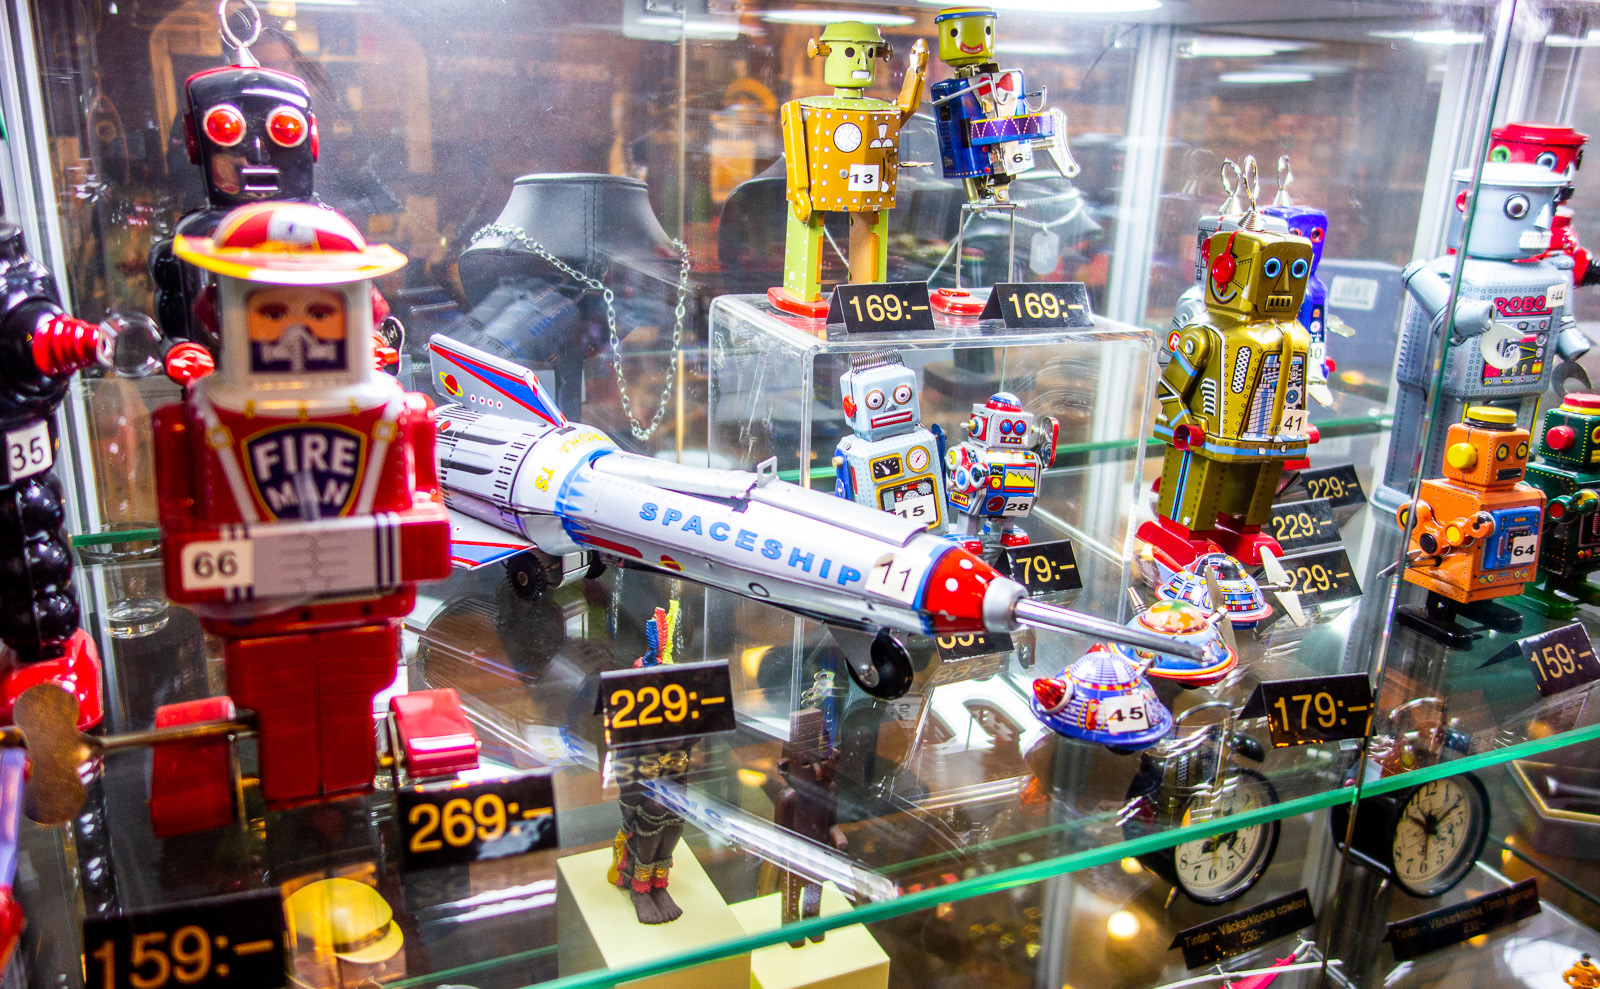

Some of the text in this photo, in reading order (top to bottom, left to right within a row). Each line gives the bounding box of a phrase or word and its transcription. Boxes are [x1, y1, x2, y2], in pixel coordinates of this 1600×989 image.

[850, 173, 874, 184] 13
[849, 294, 928, 322] 169:-
[1008, 292, 1084, 319] 169:-
[1494, 294, 1548, 314] ROBO
[1283, 415, 1302, 431] 41
[10, 437, 45, 471] 35
[253, 433, 357, 482] FIRE
[265, 478, 352, 513] MN
[1308, 476, 1358, 500] 229:-
[897, 504, 925, 519] 15
[1006, 502, 1029, 512] 28
[1272, 512, 1332, 541] 229:-
[638, 501, 862, 587] SPACESHIP
[1512, 543, 1535, 557] 64
[193, 551, 239, 579] 66
[875, 559, 912, 592] 11
[1016, 554, 1075, 584] 79:-
[1530, 643, 1592, 681] 159:-
[610, 683, 726, 729] 229:-
[1108, 706, 1144, 722] 45
[1274, 691, 1368, 732] 179:-
[408, 793, 554, 854] 269:-
[1183, 932, 1211, 948] Tintin
[1218, 909, 1276, 936] Väckarklocka
[92, 924, 275, 989] 159:-
